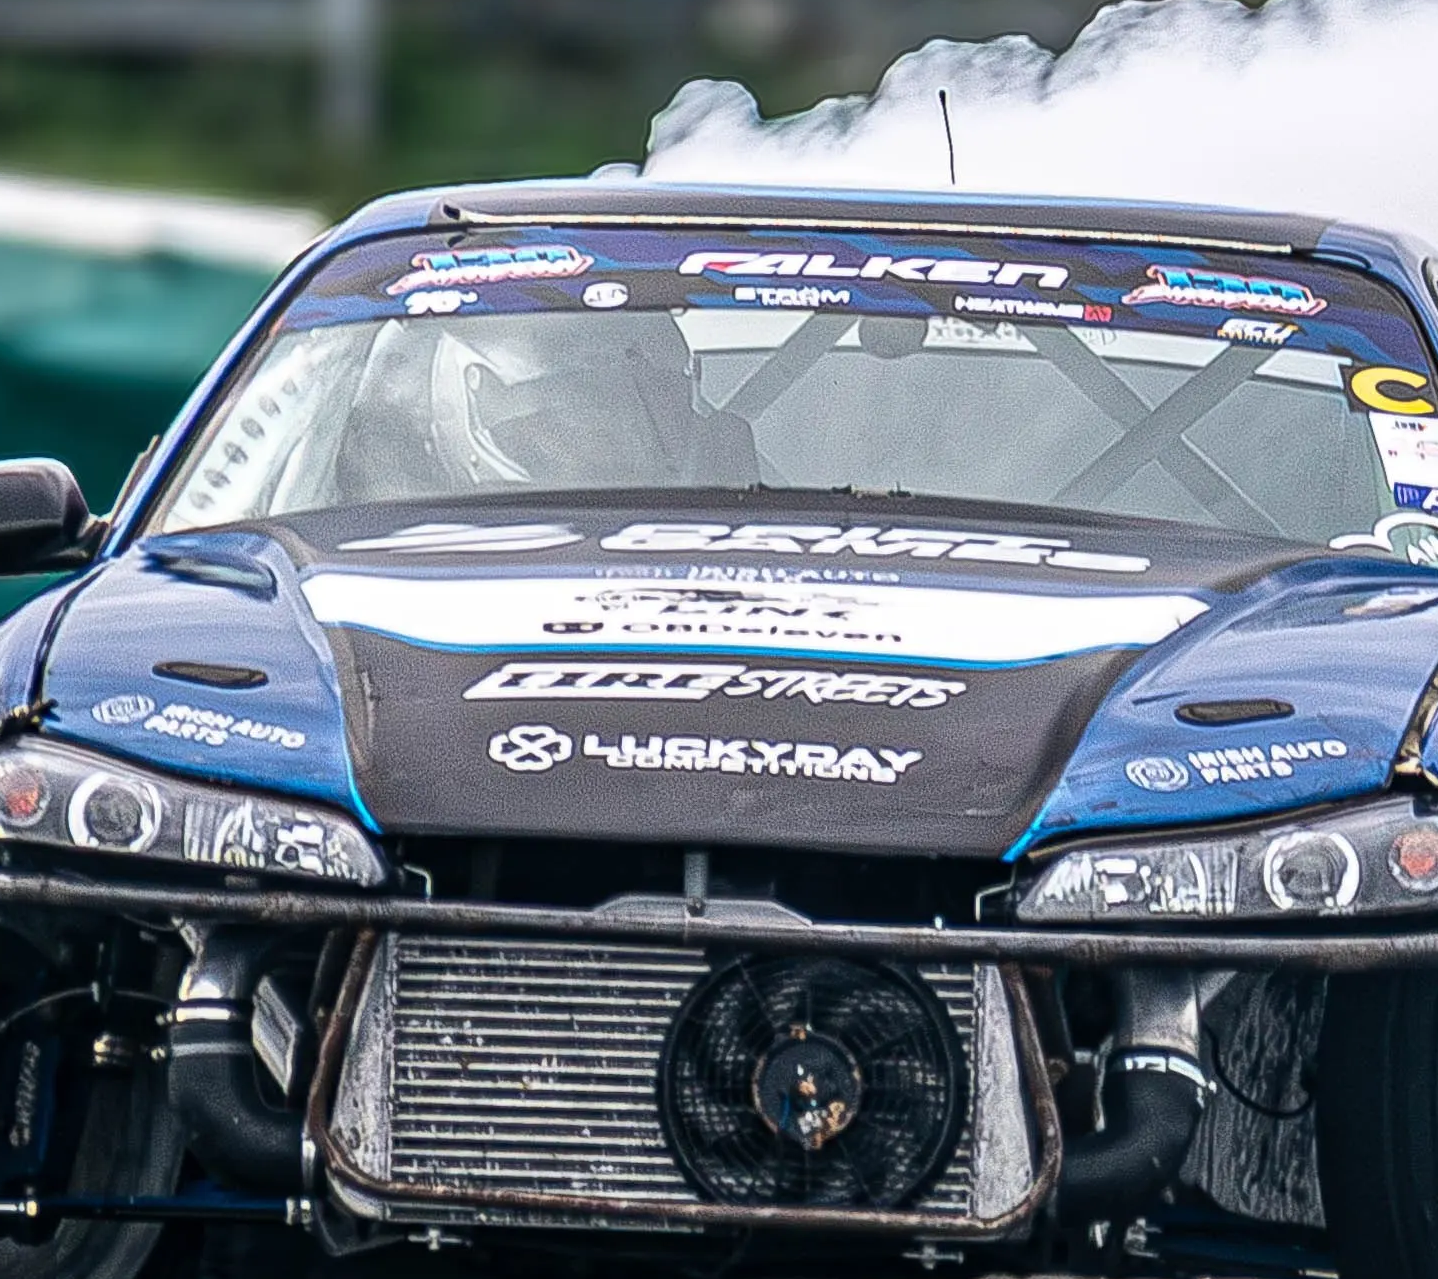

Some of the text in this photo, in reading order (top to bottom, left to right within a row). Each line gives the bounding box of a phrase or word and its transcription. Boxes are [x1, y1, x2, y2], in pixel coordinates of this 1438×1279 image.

[679, 252, 1069, 288] FALKEN
[1351, 366, 1435, 414] C
[724, 670, 967, 707] STREETS
[230, 719, 306, 749] AUTO
[1271, 739, 1348, 762] AUTO
[1200, 761, 1293, 785] PARTS
